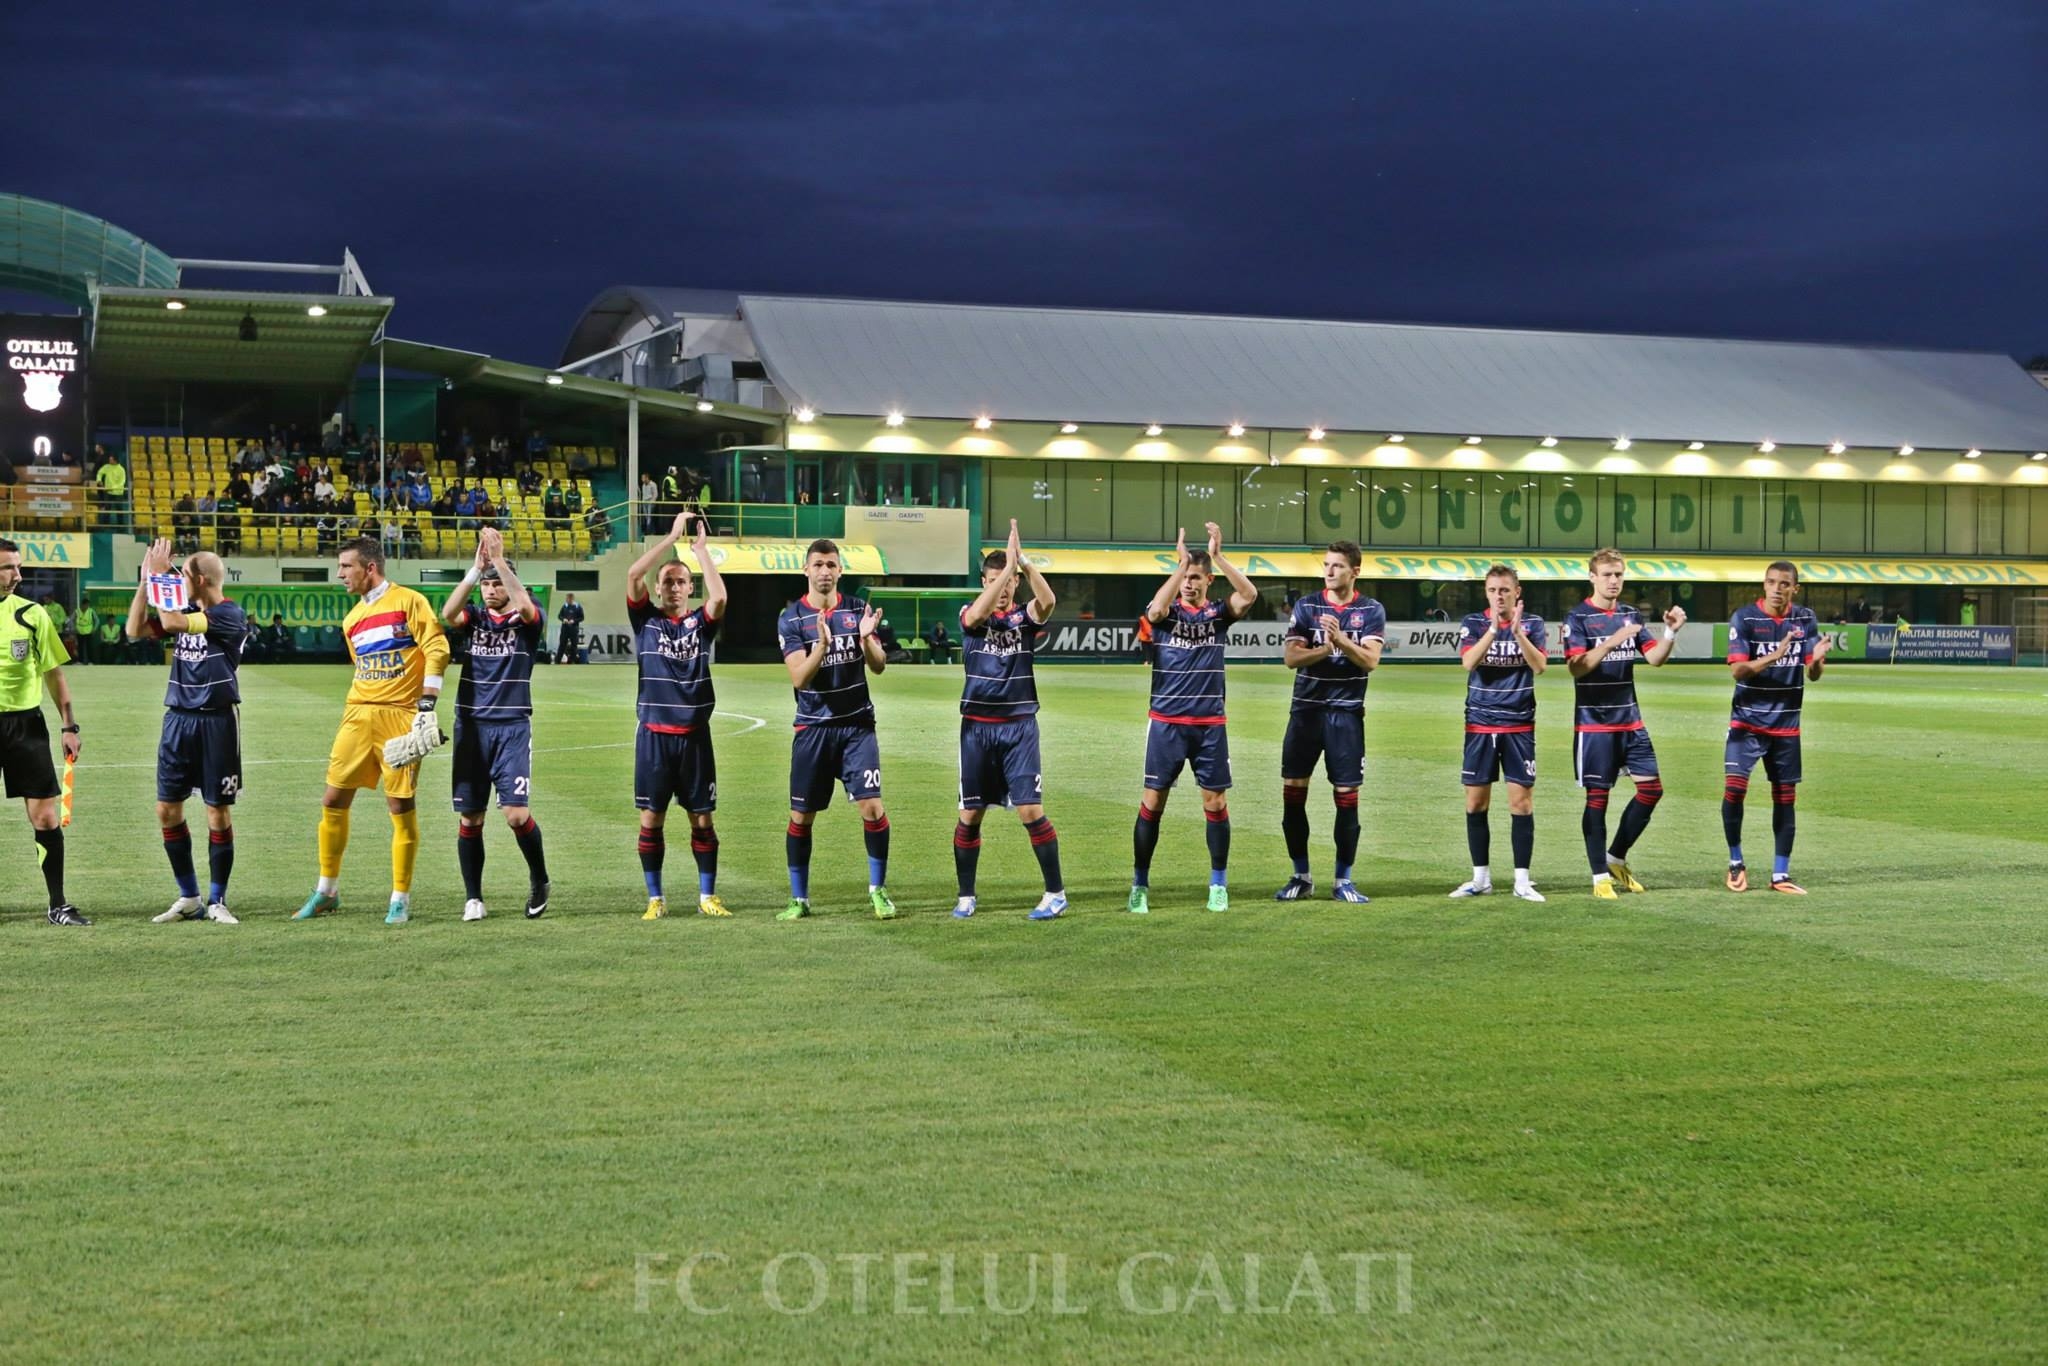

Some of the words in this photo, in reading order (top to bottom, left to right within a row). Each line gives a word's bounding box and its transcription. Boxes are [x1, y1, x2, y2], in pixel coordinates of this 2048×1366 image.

[7, 339, 78, 355] OTELUL
[9, 356, 75, 372] GALATI
[1319, 486, 1806, 534] CONCORDIA
[17, 542, 70, 562] NA
[1797, 563, 2039, 583] ONCORDIA
[1171, 620, 1216, 638] ASTRA
[1900, 629, 1934, 638] MILITARI
[1937, 630, 1980, 639] RESIDENCE
[1945, 650, 1954, 658] DE
[221, 775, 238, 795] 29
[863, 769, 880, 788] 20
